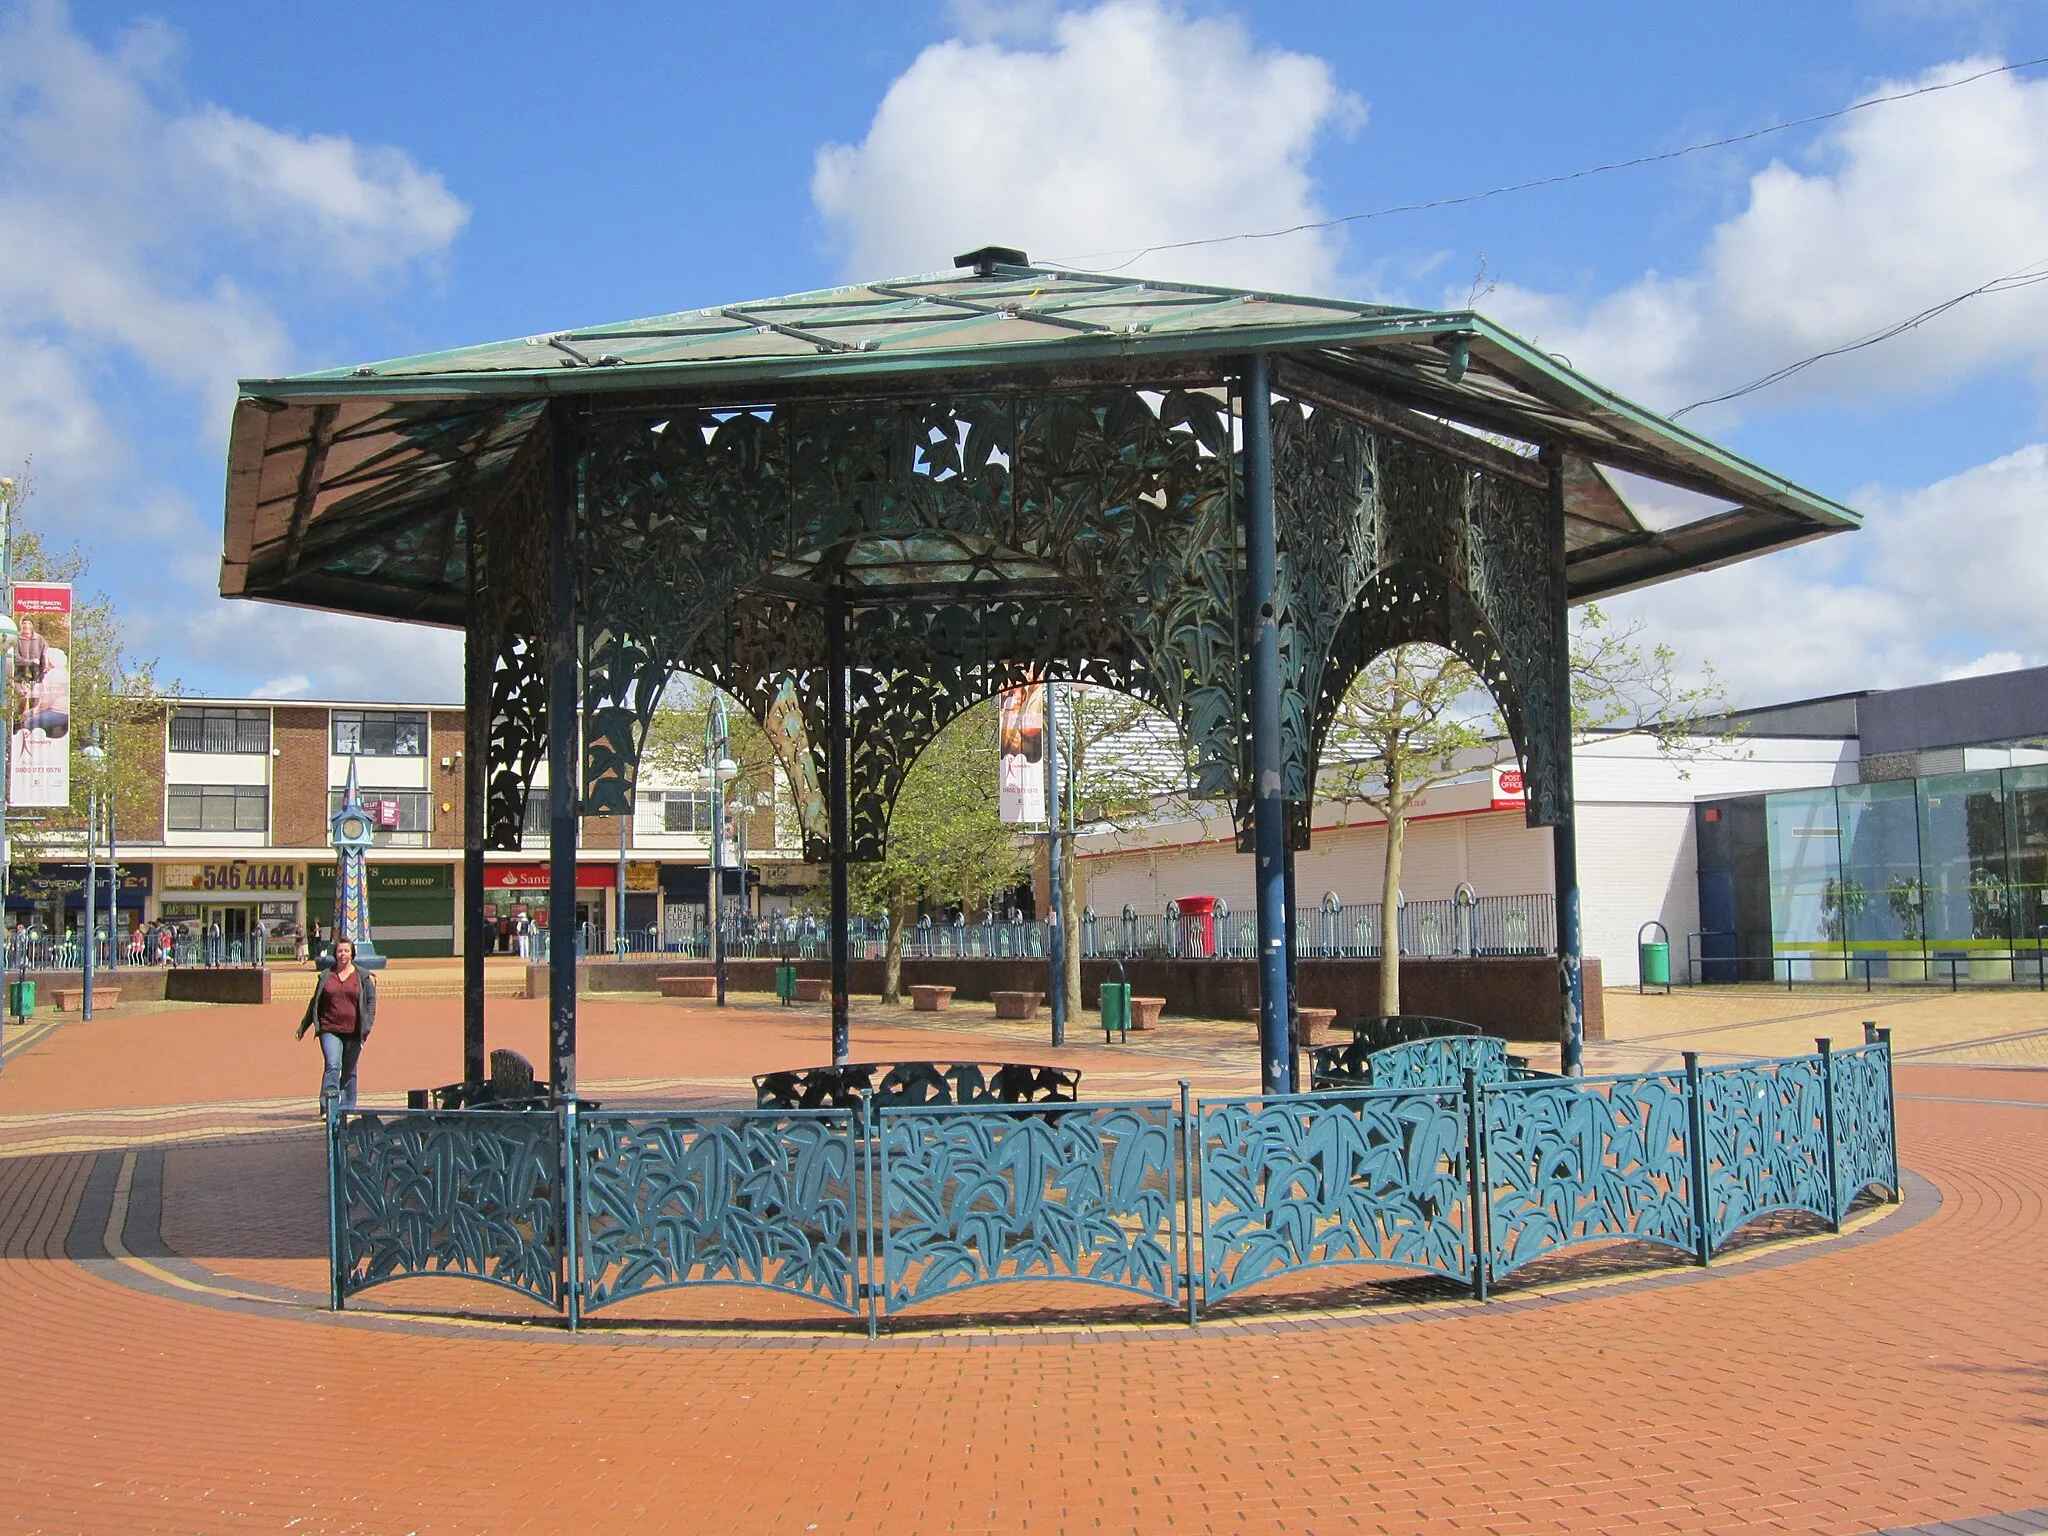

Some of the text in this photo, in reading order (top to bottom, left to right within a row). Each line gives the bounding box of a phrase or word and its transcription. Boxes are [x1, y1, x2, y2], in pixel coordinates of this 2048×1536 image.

[166, 865, 200, 875] ACORN
[124, 877, 147, 888] £1
[166, 876, 192, 887] CARS
[203, 865, 294, 890] 546 4444
[382, 878, 435, 886] CARD SHOP
[167, 904, 197, 915] ACRN
[262, 903, 294, 914] ACRN
